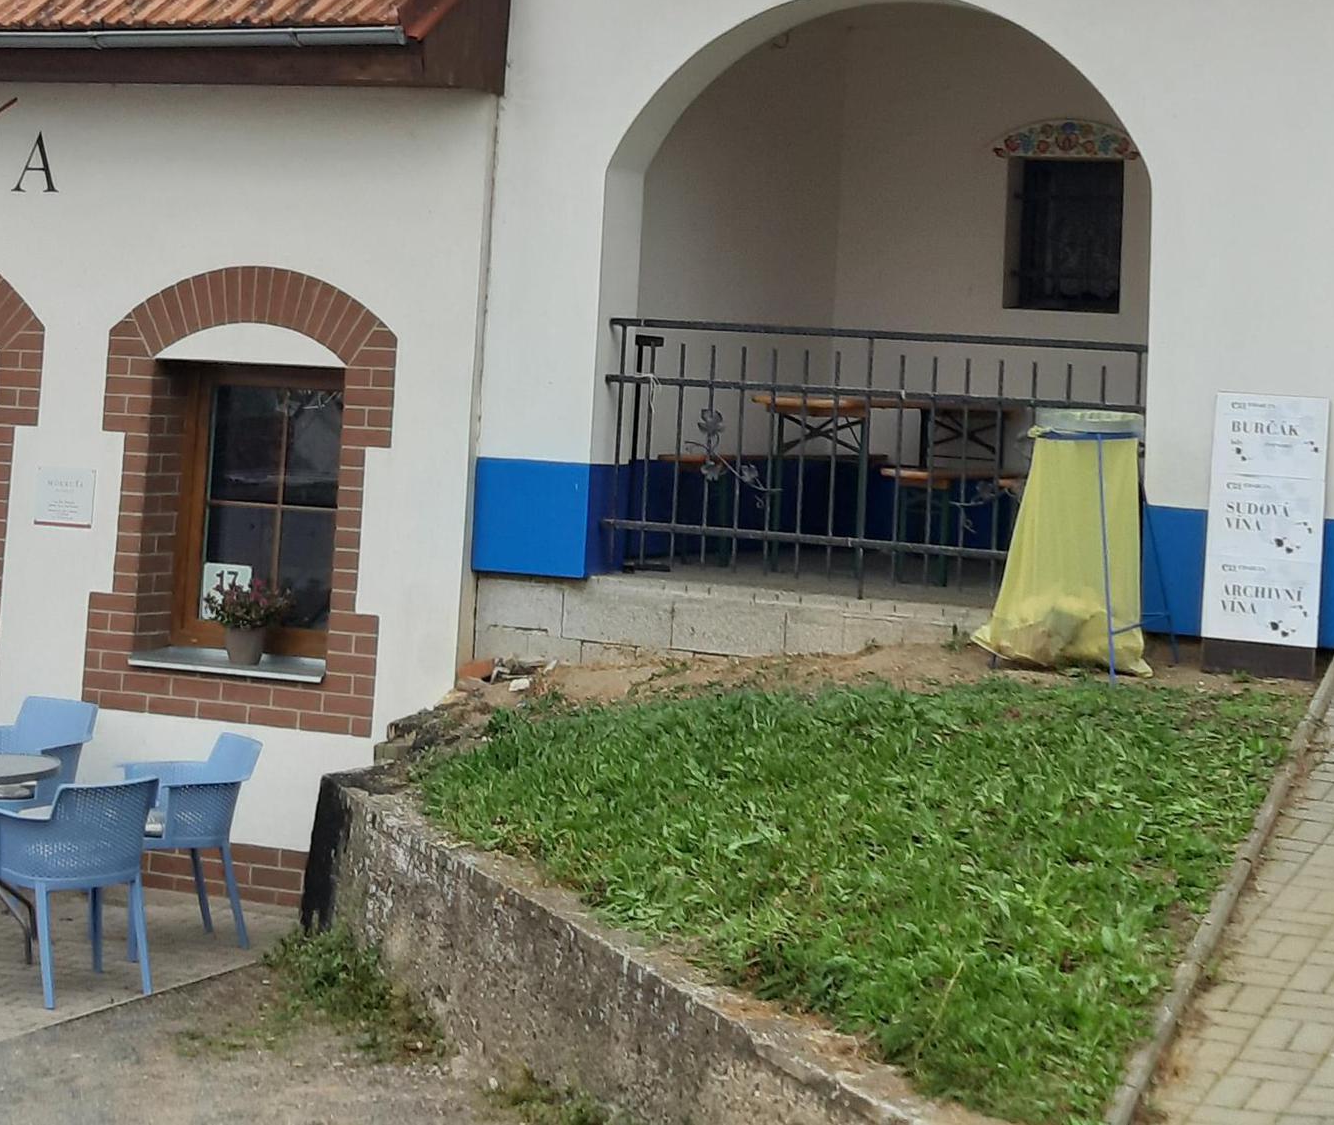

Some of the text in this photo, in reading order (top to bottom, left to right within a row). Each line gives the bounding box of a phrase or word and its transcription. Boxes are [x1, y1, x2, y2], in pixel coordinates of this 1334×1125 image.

[1231, 420, 1299, 437] BURČÁK
[1226, 501, 1290, 518] SUDOVÁ
[1225, 515, 1262, 532] VÍNA
[1223, 583, 1304, 602] ARCHIVNÍ
[1220, 597, 1257, 615] VÍNA
